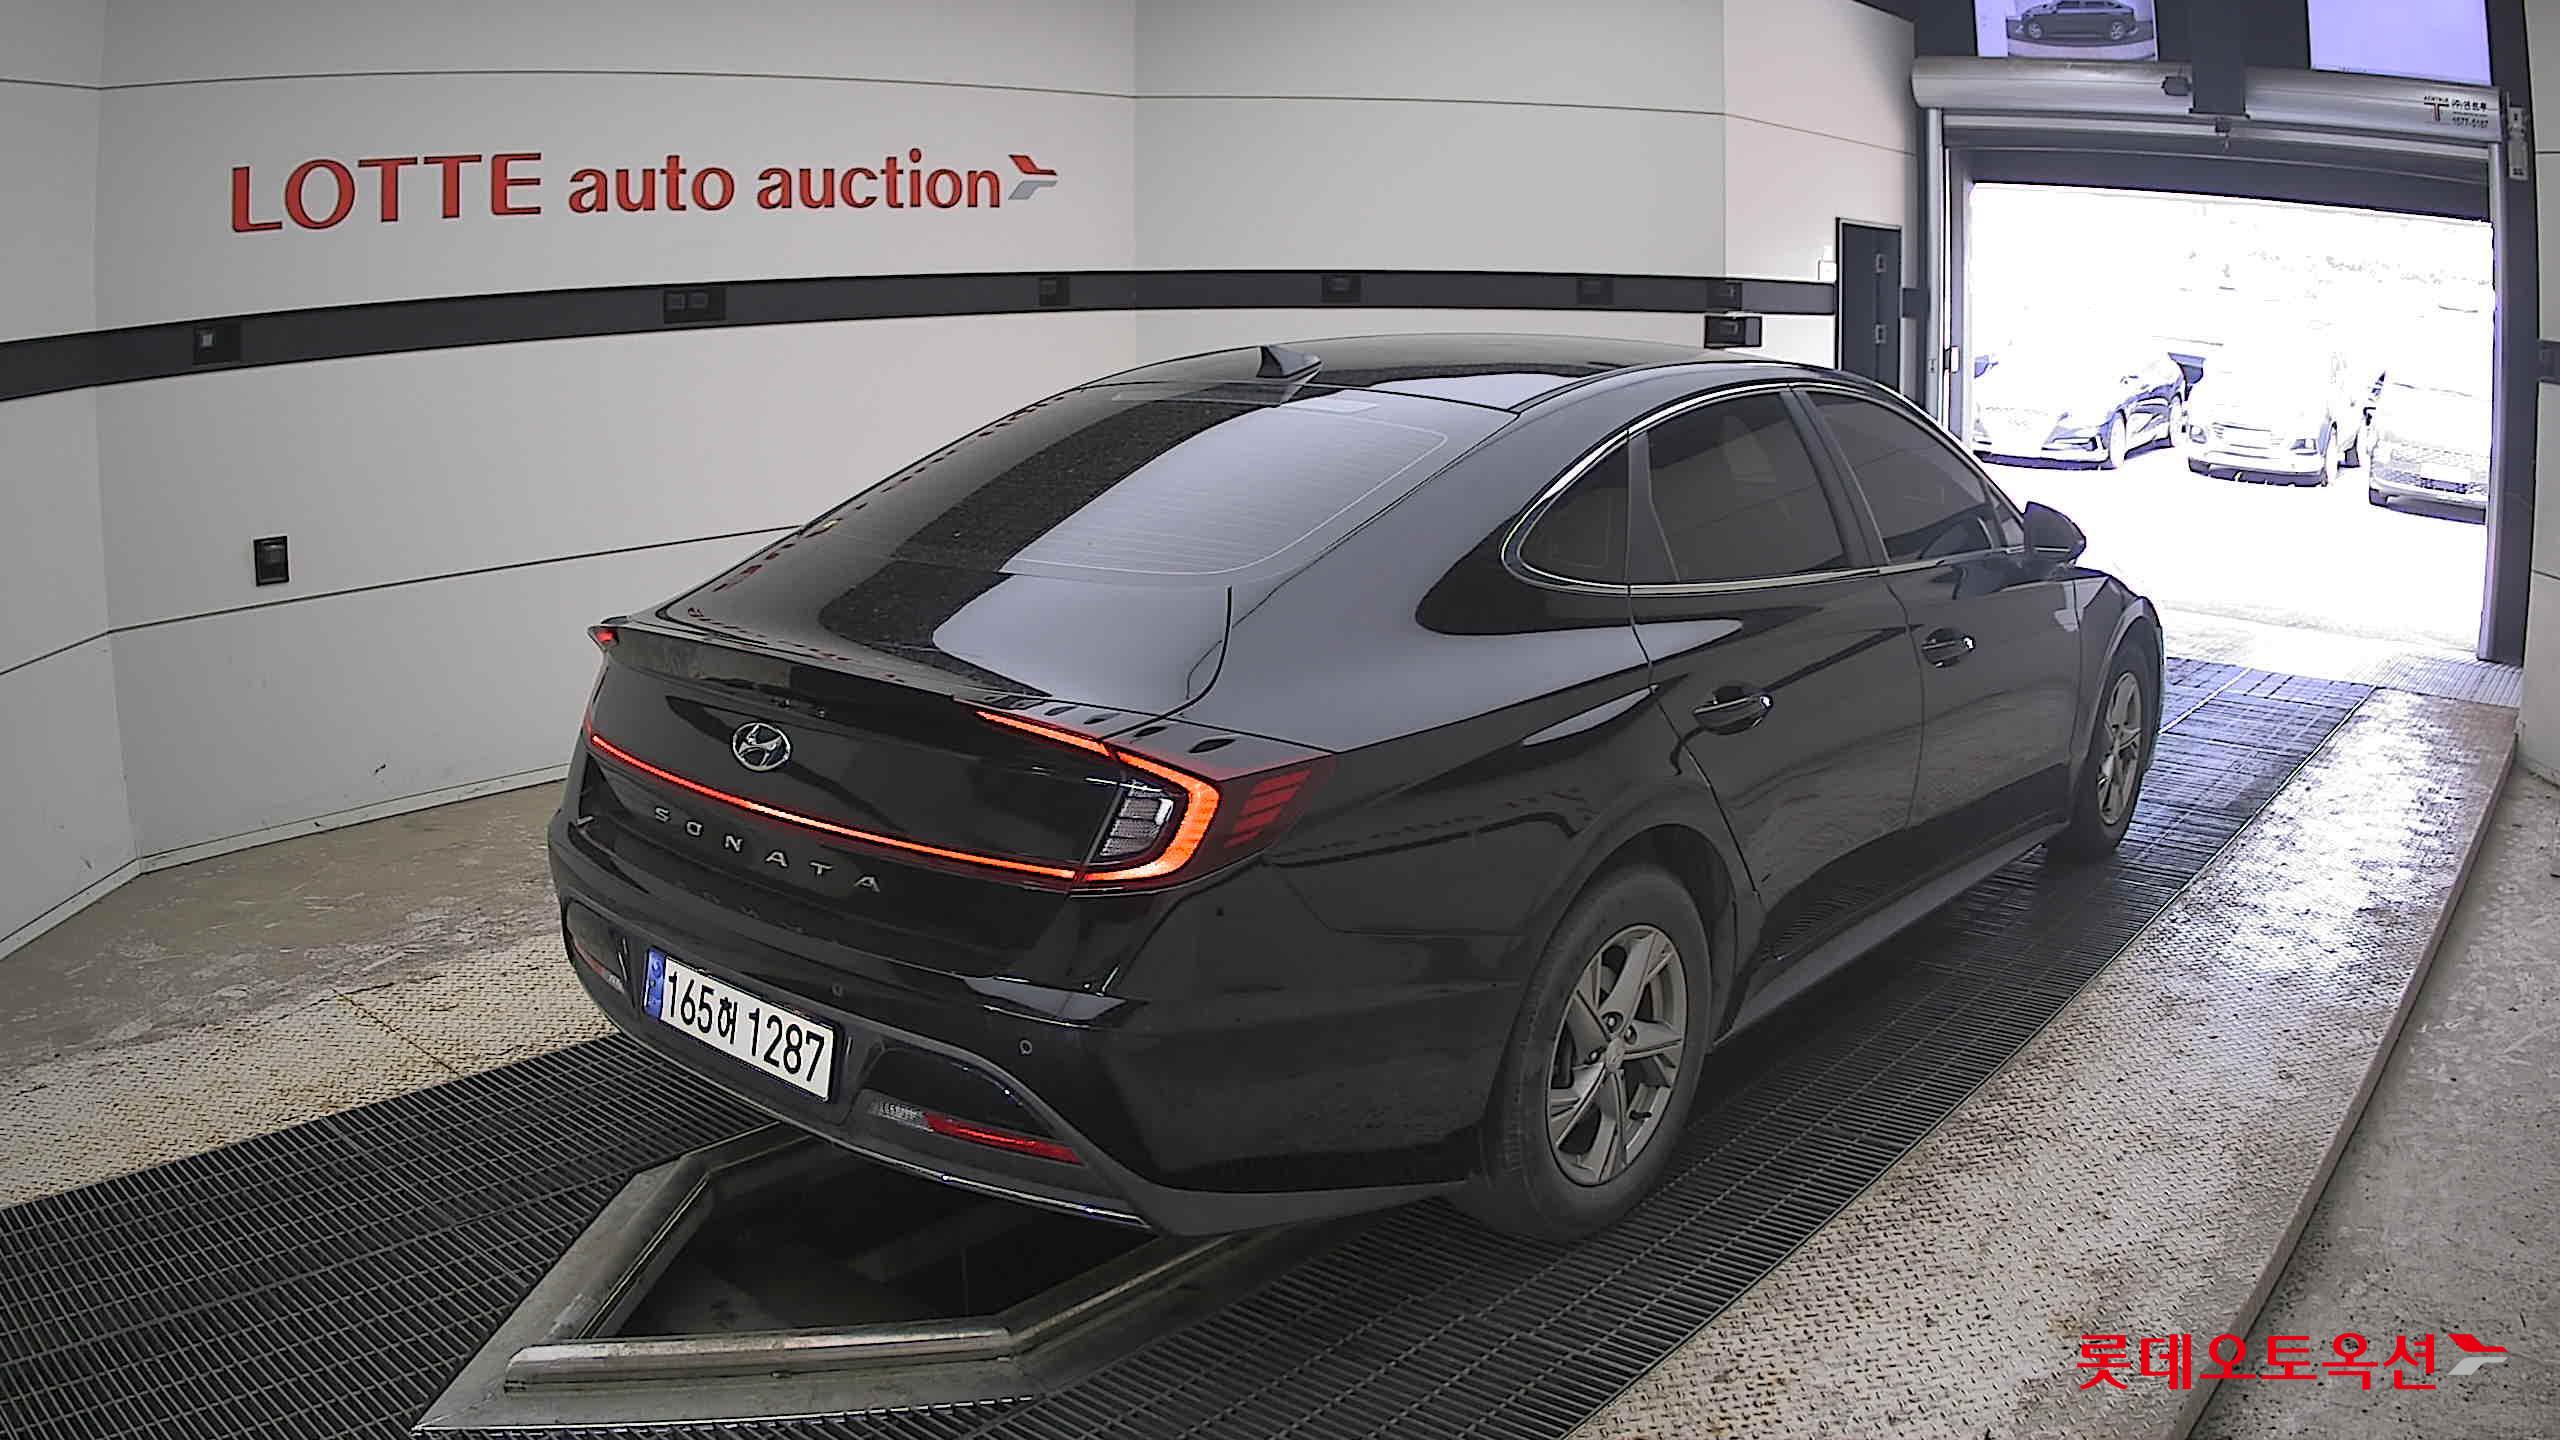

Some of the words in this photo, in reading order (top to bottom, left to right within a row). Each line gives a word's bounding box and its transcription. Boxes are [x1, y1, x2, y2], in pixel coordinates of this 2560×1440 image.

[232, 152, 542, 233] LOTTE
[569, 155, 736, 214] auto
[758, 149, 1002, 208] auction
[652, 805, 882, 894] SONATA
[667, 970, 738, 1045] 165허
[748, 1007, 826, 1083] 1287
